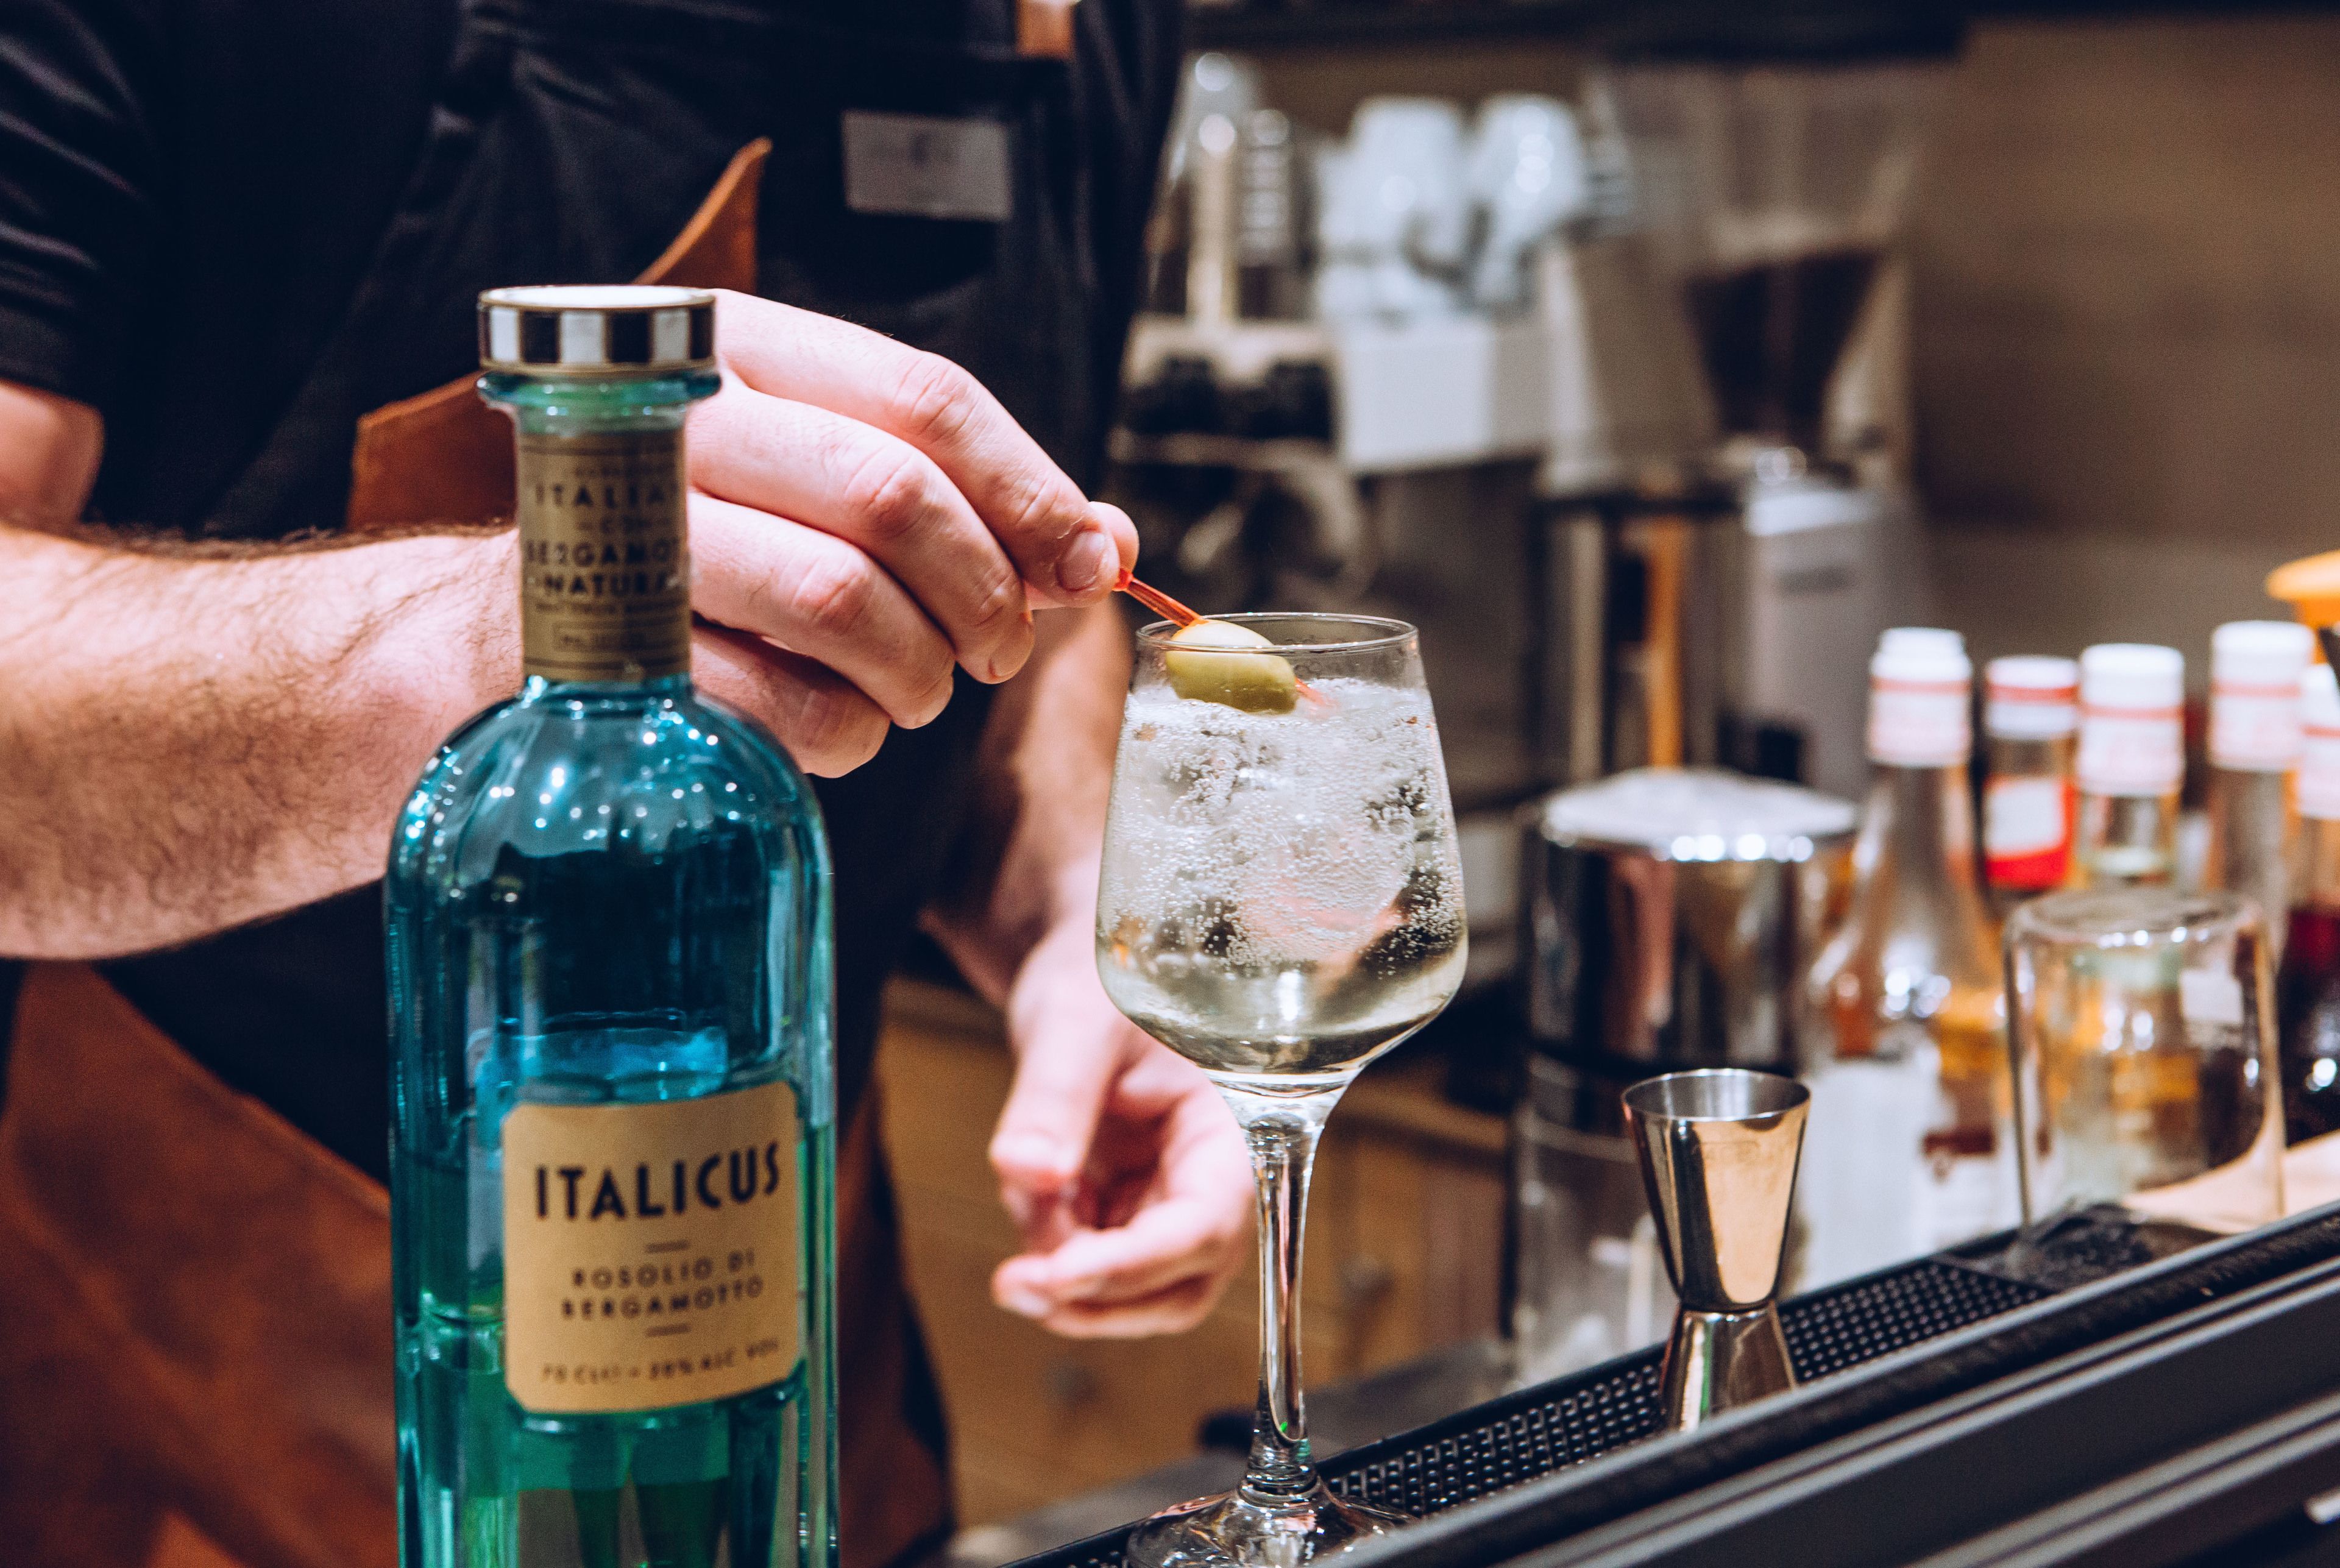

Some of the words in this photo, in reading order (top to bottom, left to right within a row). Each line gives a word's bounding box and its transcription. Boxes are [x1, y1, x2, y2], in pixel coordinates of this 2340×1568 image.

[536, 1140, 779, 1222] ITALICUS
[571, 1255, 714, 1290] ROSOLIO
[561, 1273, 764, 1321] BERGAMOTTO
